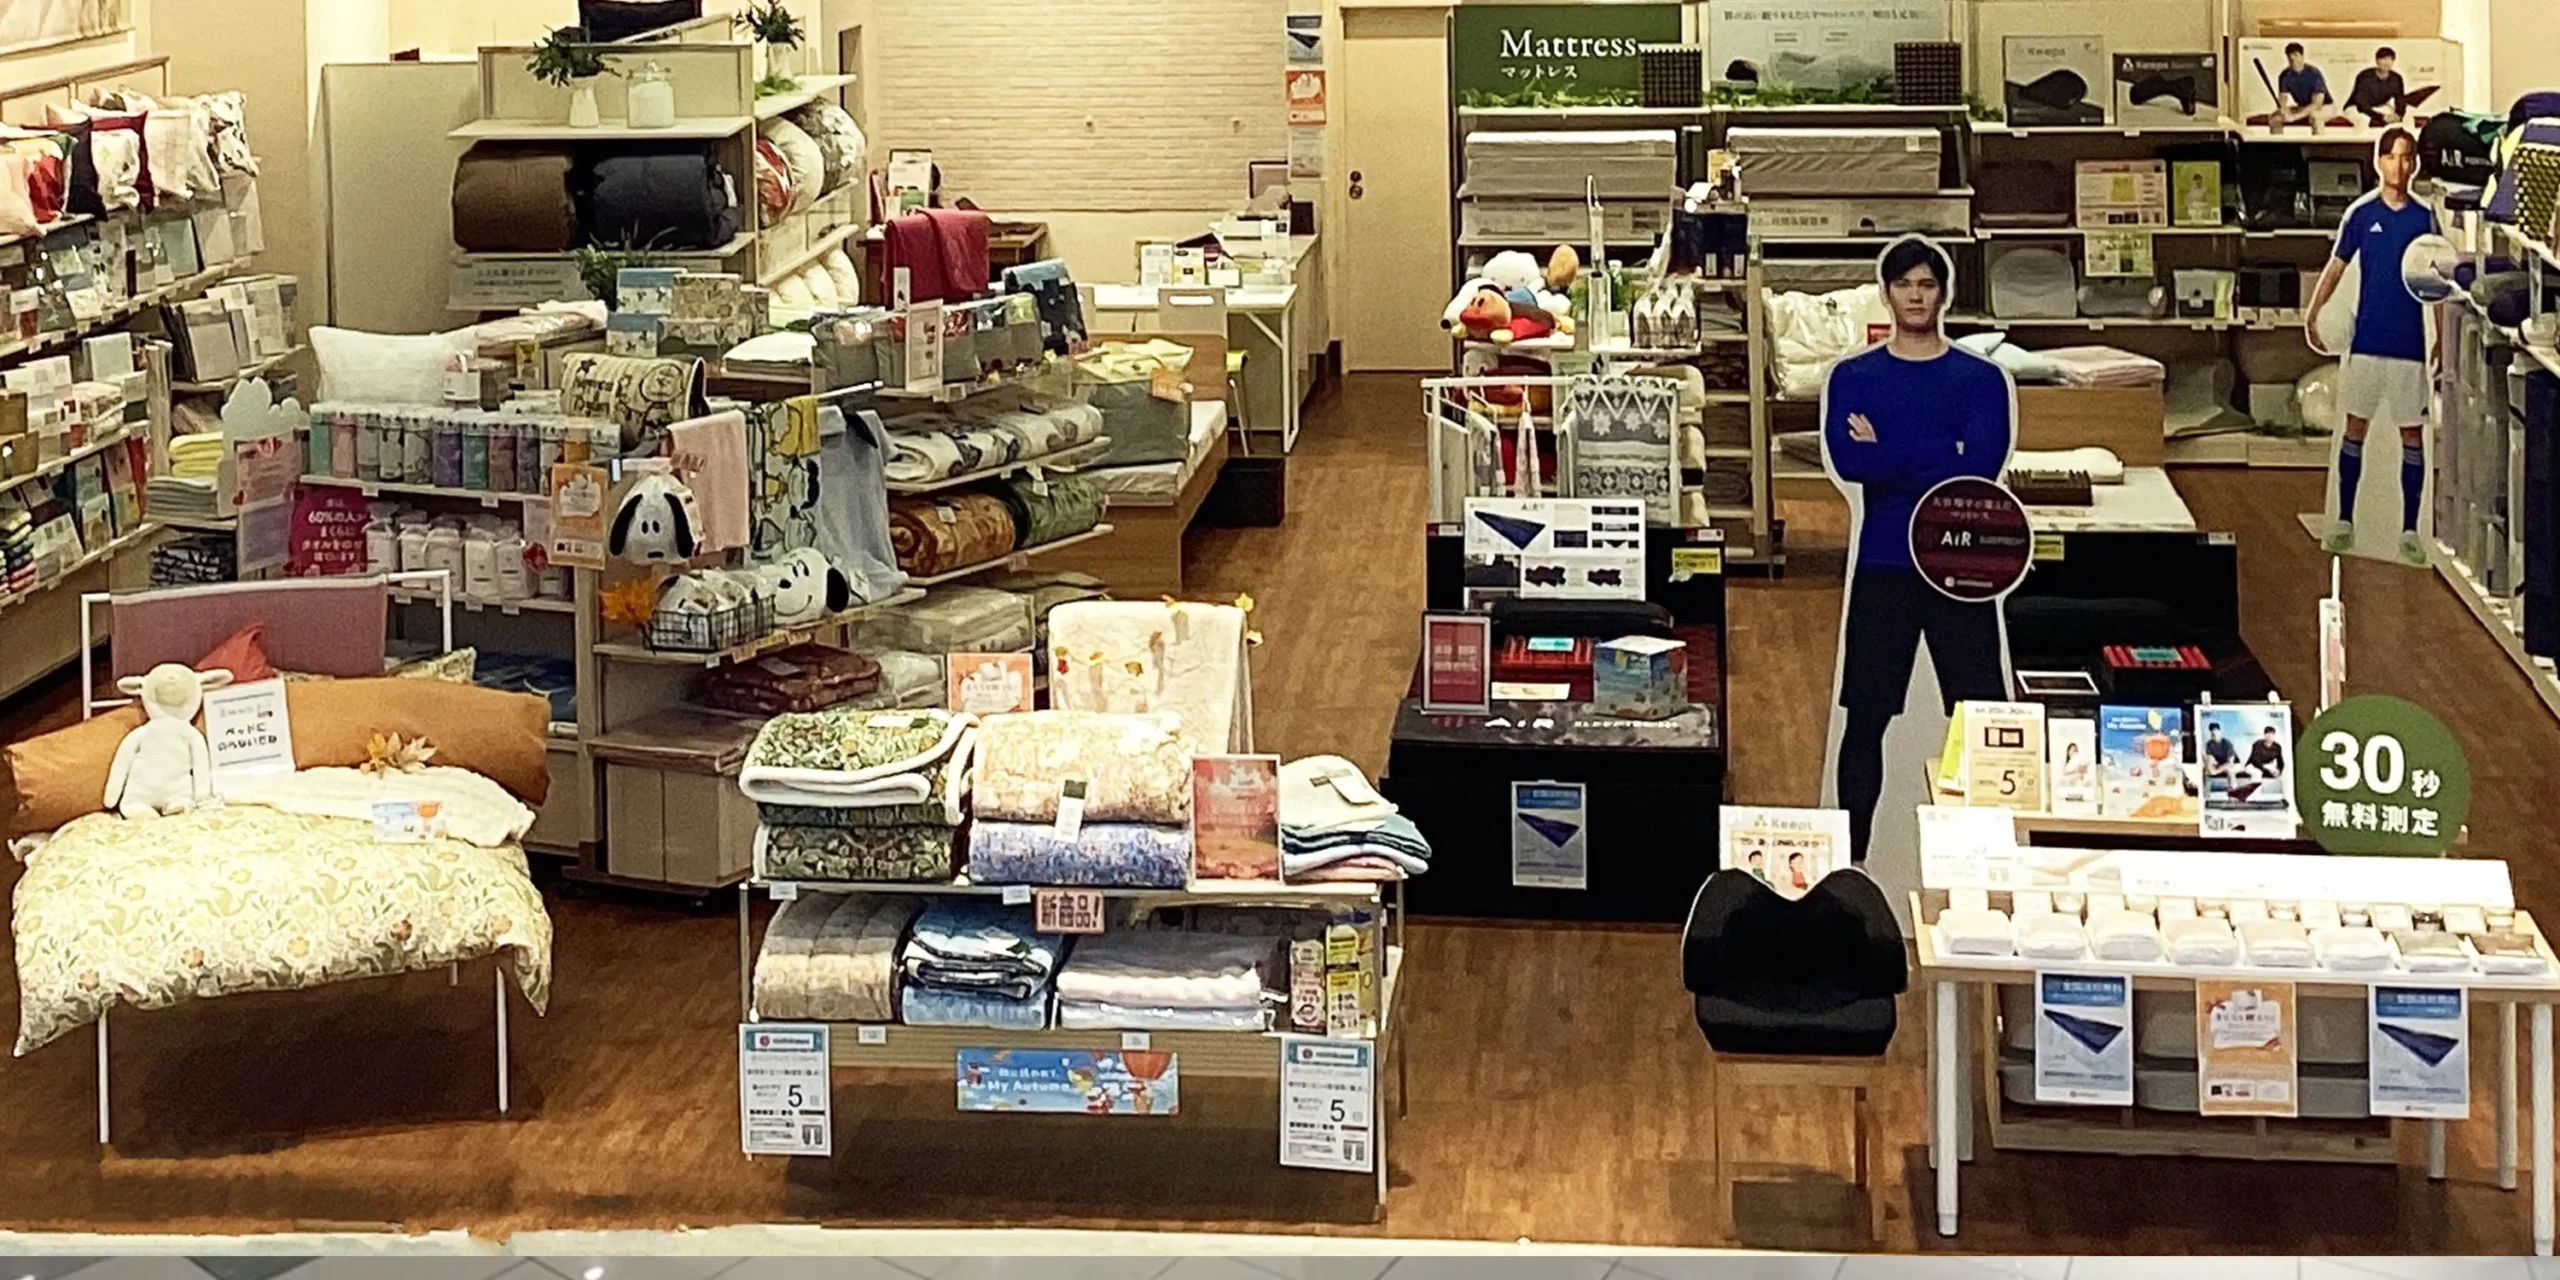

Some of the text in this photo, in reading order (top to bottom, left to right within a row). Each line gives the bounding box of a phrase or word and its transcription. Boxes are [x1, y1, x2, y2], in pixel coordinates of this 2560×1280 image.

[1500, 29, 1637, 57] Mattress
[1501, 64, 1578, 79] マットレス
[1941, 530, 1972, 547] AiR
[2320, 731, 2441, 798] 30秒
[2000, 769, 2016, 795] 5
[2321, 800, 2439, 836] 無料測定
[1041, 891, 1100, 928] 新商品!
[788, 1084, 803, 1107] 5
[987, 1080, 1009, 1093] My
[1330, 1099, 1345, 1122] 5
